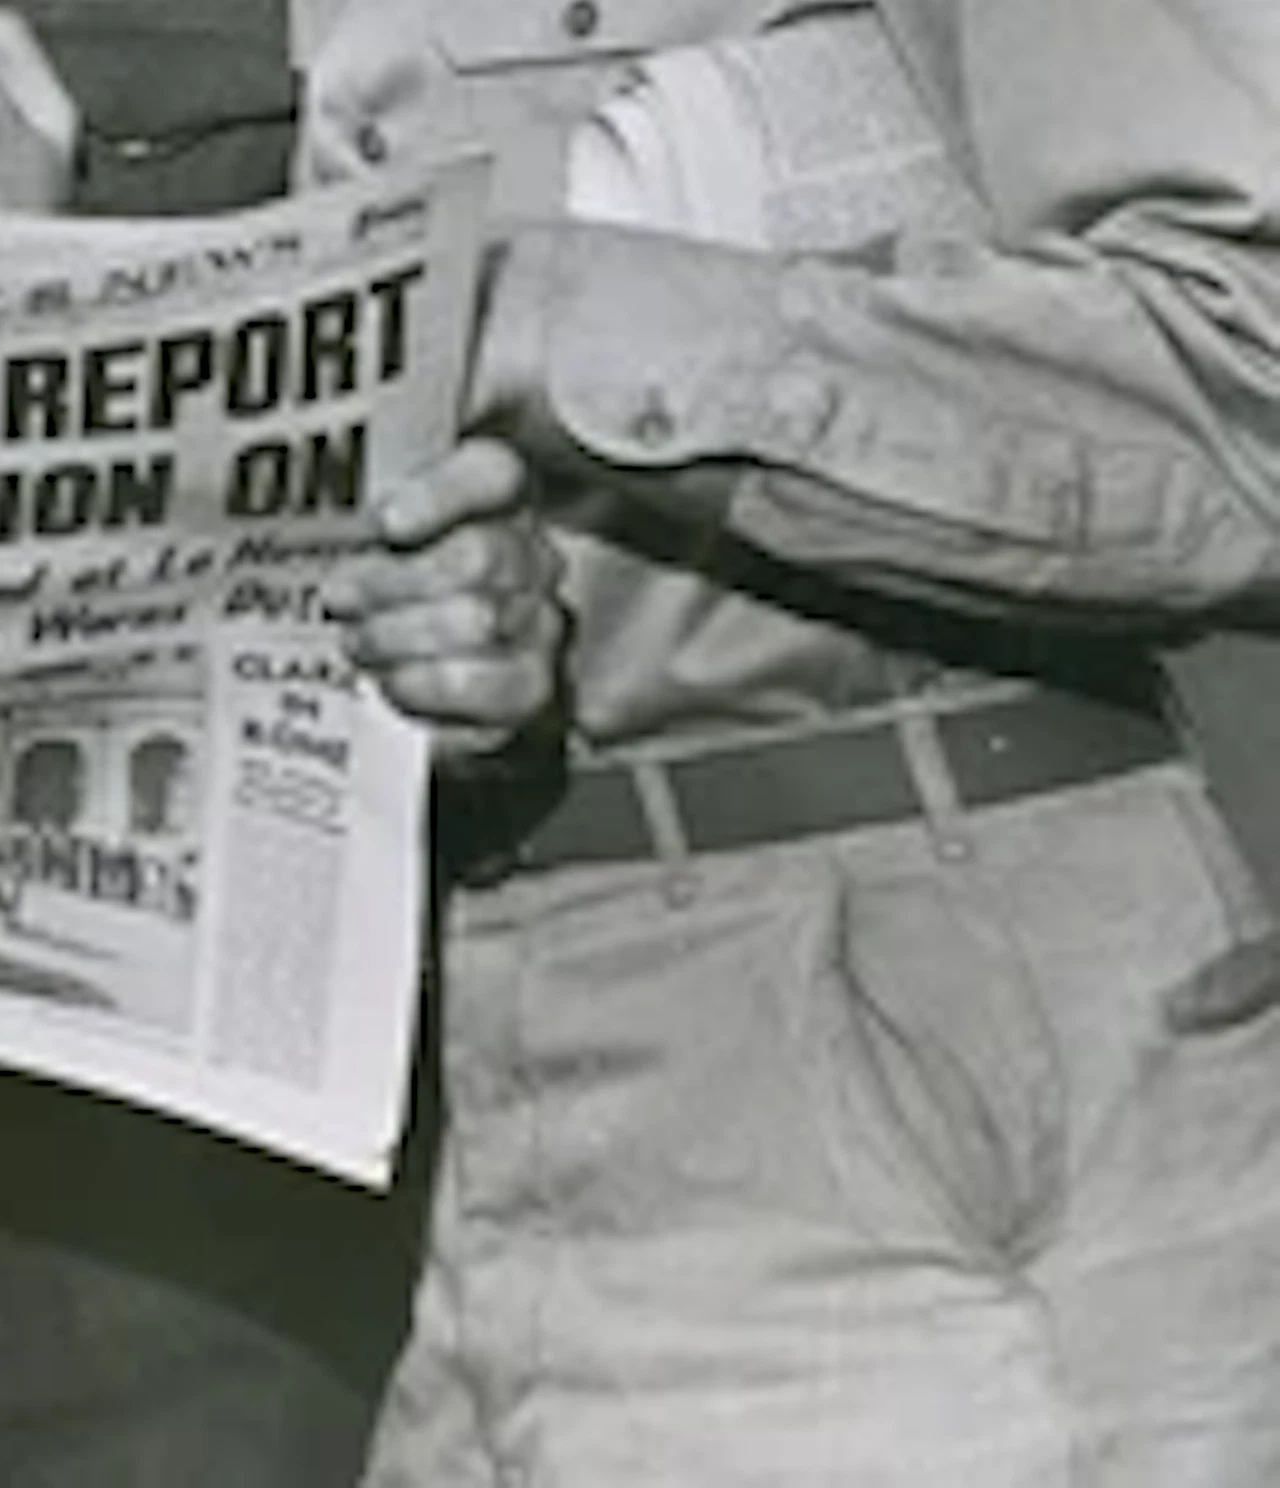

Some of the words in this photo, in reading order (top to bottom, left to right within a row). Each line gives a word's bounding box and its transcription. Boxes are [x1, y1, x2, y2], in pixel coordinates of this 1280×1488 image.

[98, 232, 304, 307] NEWS
[0, 262, 428, 443] REPORT
[224, 420, 370, 519] ON
